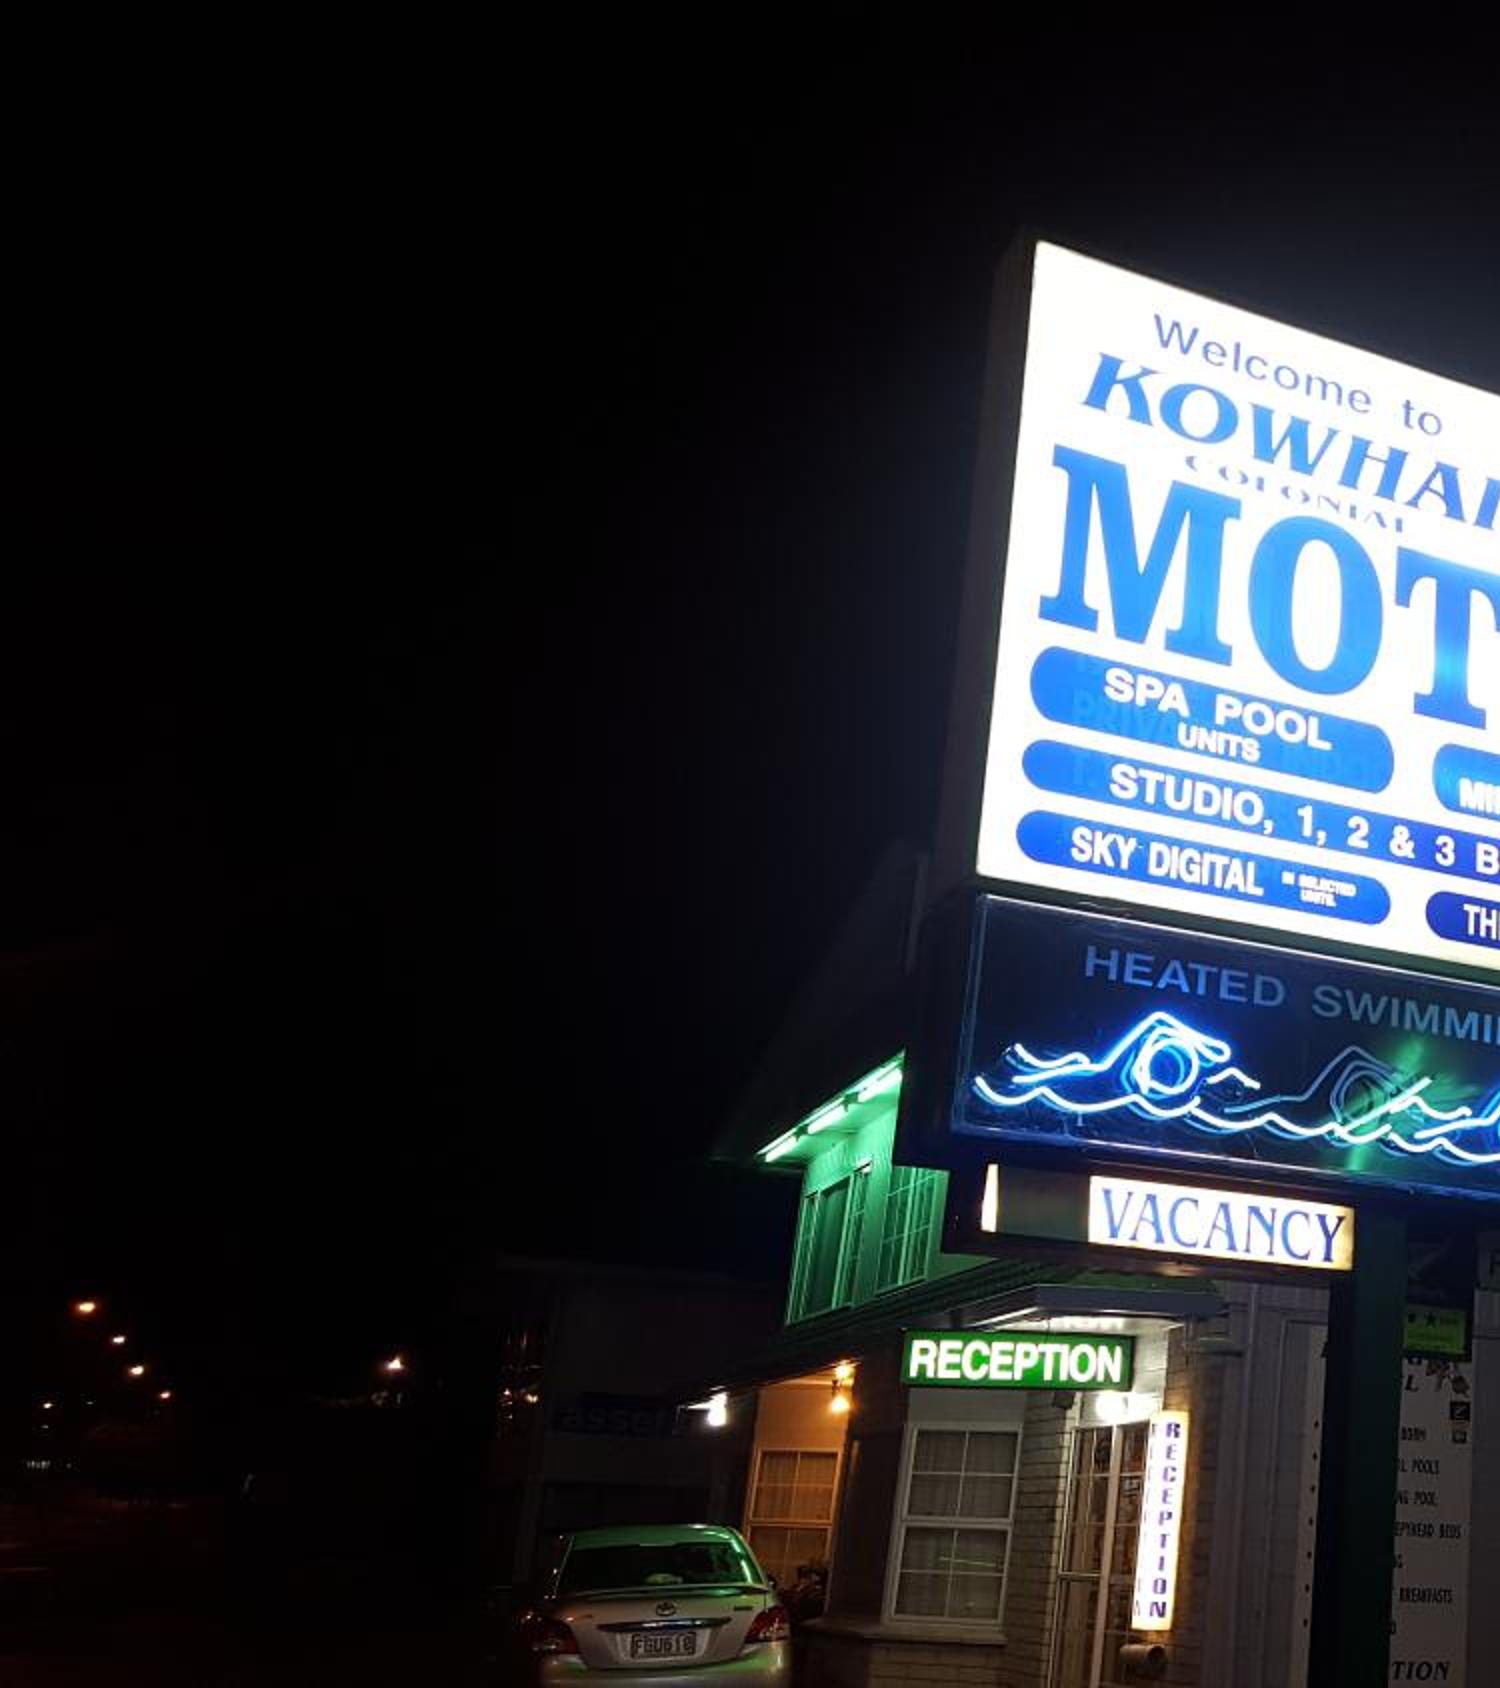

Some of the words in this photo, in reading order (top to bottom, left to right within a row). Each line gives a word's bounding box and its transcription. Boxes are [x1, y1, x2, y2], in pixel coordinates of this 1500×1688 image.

[1153, 313, 1373, 414] Welcome
[1403, 398, 1444, 437] to
[1104, 667, 1190, 718] SPA
[1215, 694, 1333, 752] POOL
[1177, 722, 1262, 763] UNITS
[1109, 763, 1274, 834] STUDIO,
[1296, 804, 1328, 847] 1,
[1346, 815, 1370, 849] 2
[1388, 825, 1416, 859] &
[1434, 835, 1456, 867] 3
[1070, 825, 1138, 872] SKY
[1147, 843, 1265, 897] DIGITAL
[1084, 945, 1286, 1008] HEATED
[1101, 1187, 1348, 1264] VACANCY
[908, 1339, 1123, 1383] RECEPTION
[1149, 1422, 1181, 1619] RECEPTION
